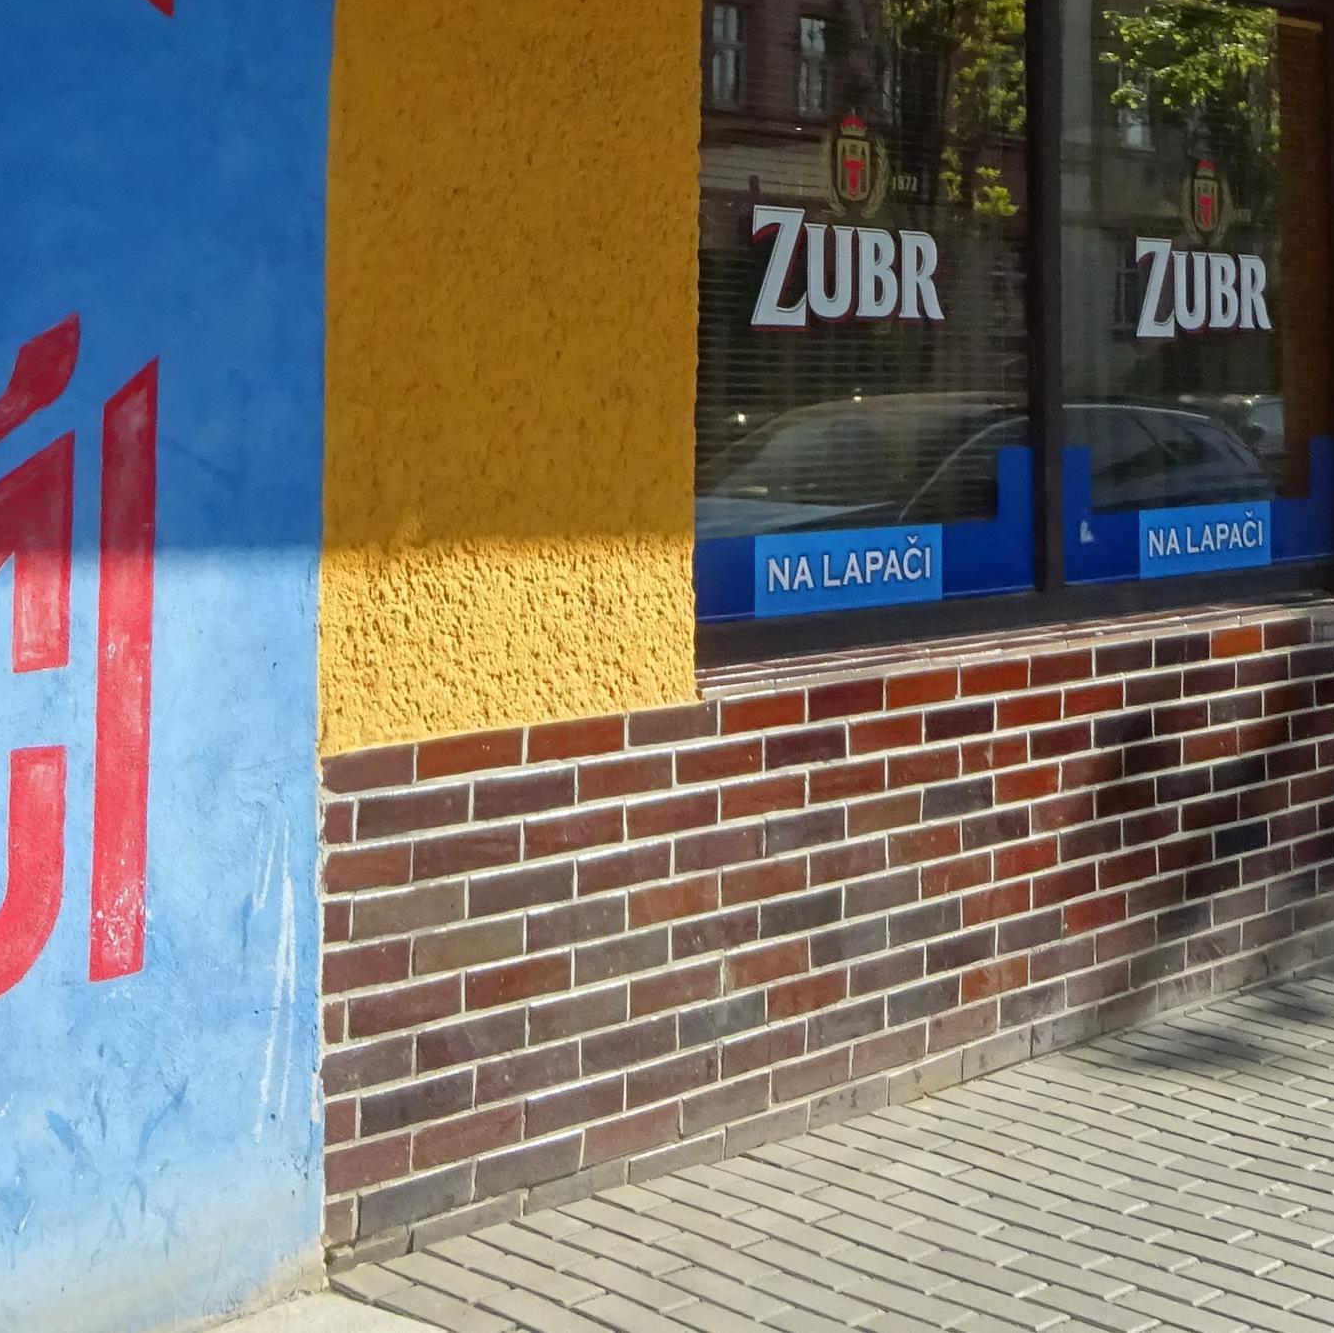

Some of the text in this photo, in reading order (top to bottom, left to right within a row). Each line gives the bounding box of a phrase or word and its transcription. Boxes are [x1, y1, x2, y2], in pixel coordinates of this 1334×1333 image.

[751, 204, 945, 331] ZUBR
[1135, 237, 1271, 338] ZUBR
[768, 535, 931, 592] NA LAPAČI
[1148, 510, 1263, 558] NA LAPAČI
